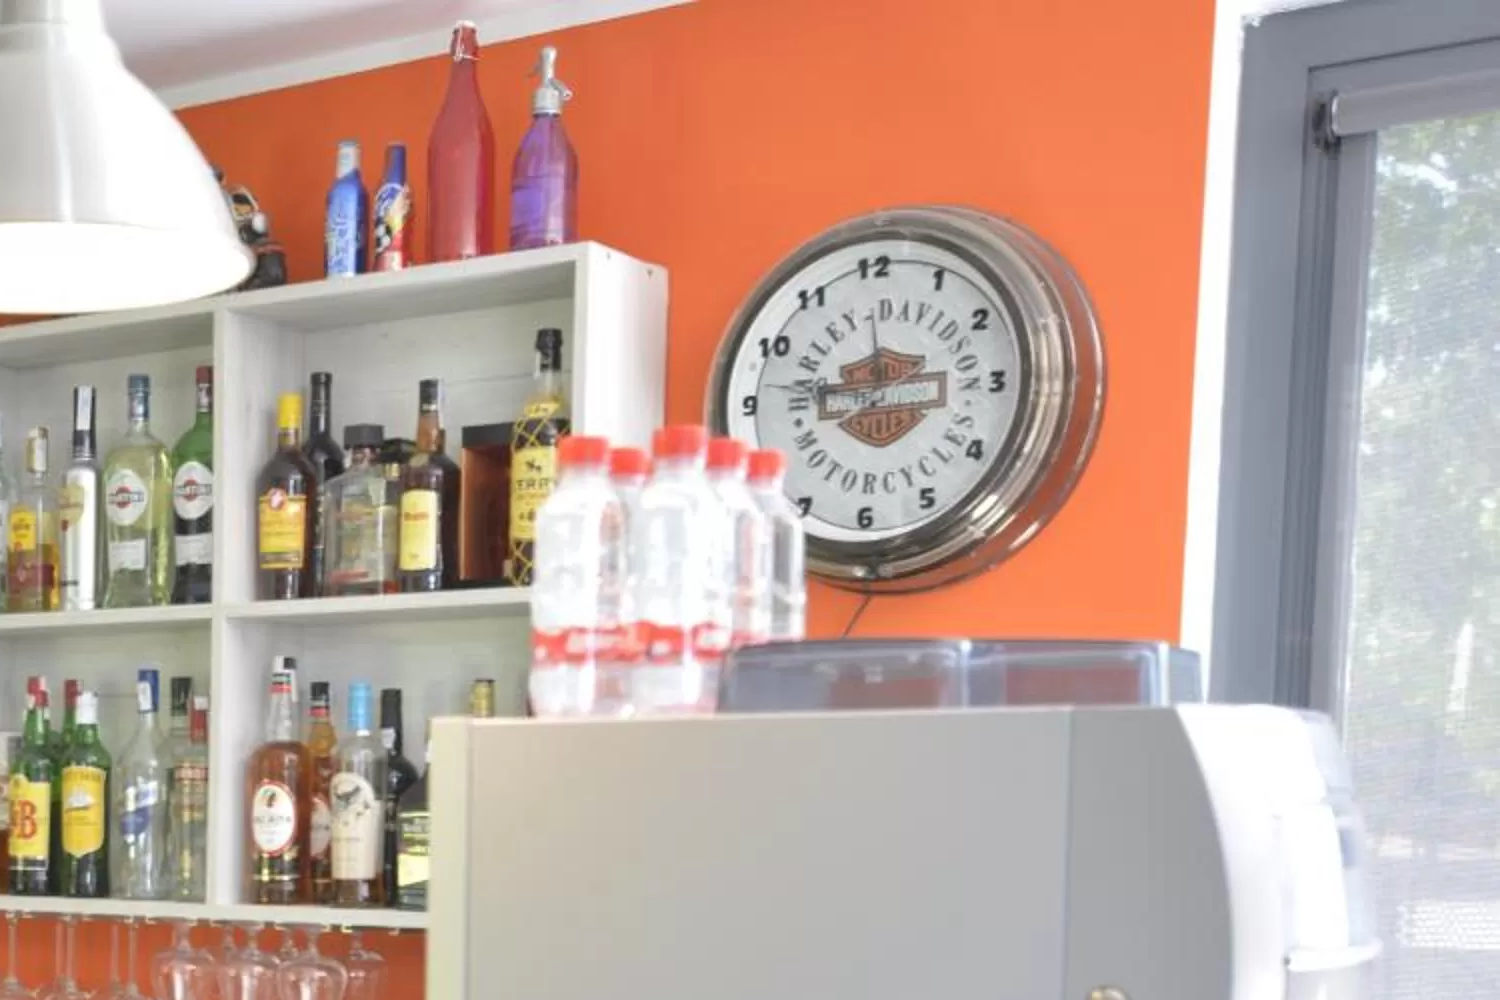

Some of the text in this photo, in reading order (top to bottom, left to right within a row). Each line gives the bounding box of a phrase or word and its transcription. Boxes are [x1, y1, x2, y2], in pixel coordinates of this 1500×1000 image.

[858, 256, 891, 279] 12
[933, 269, 945, 291] 1
[799, 286, 826, 310] 11
[972, 309, 989, 331] 2
[758, 335, 790, 358] 10
[989, 371, 1005, 392] 3
[742, 395, 757, 417] 9
[793, 412, 976, 494] MOTORCYCLES
[966, 439, 984, 461] 4
[919, 487, 936, 508] 5
[857, 506, 873, 529] 6
